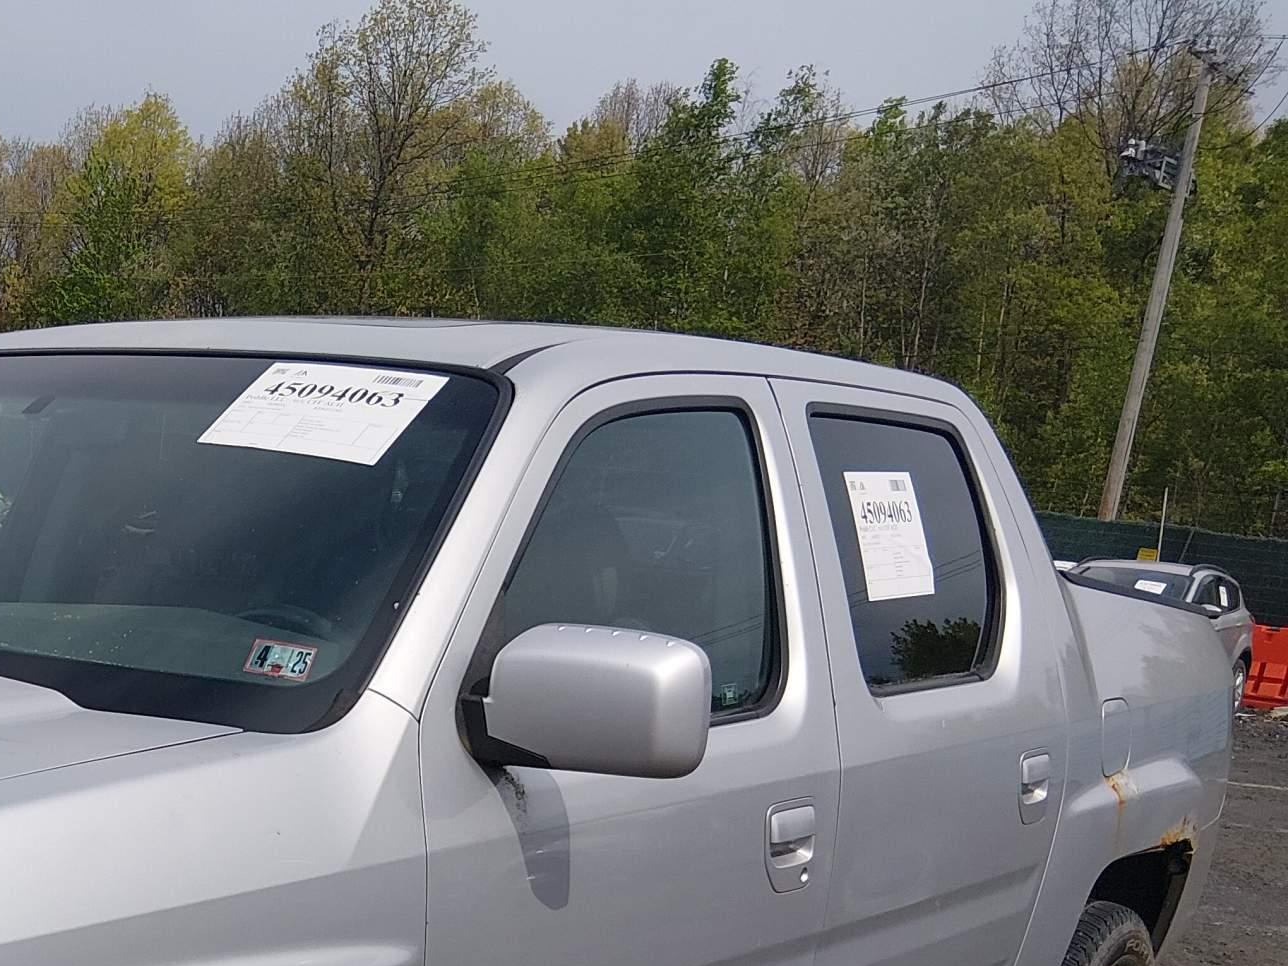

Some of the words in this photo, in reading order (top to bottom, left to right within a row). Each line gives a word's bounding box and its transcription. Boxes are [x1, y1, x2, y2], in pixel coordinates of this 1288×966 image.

[264, 380, 405, 409] 45094063
[860, 500, 913, 525] 45094063
[254, 645, 271, 668] 4
[290, 650, 312, 674] 25
